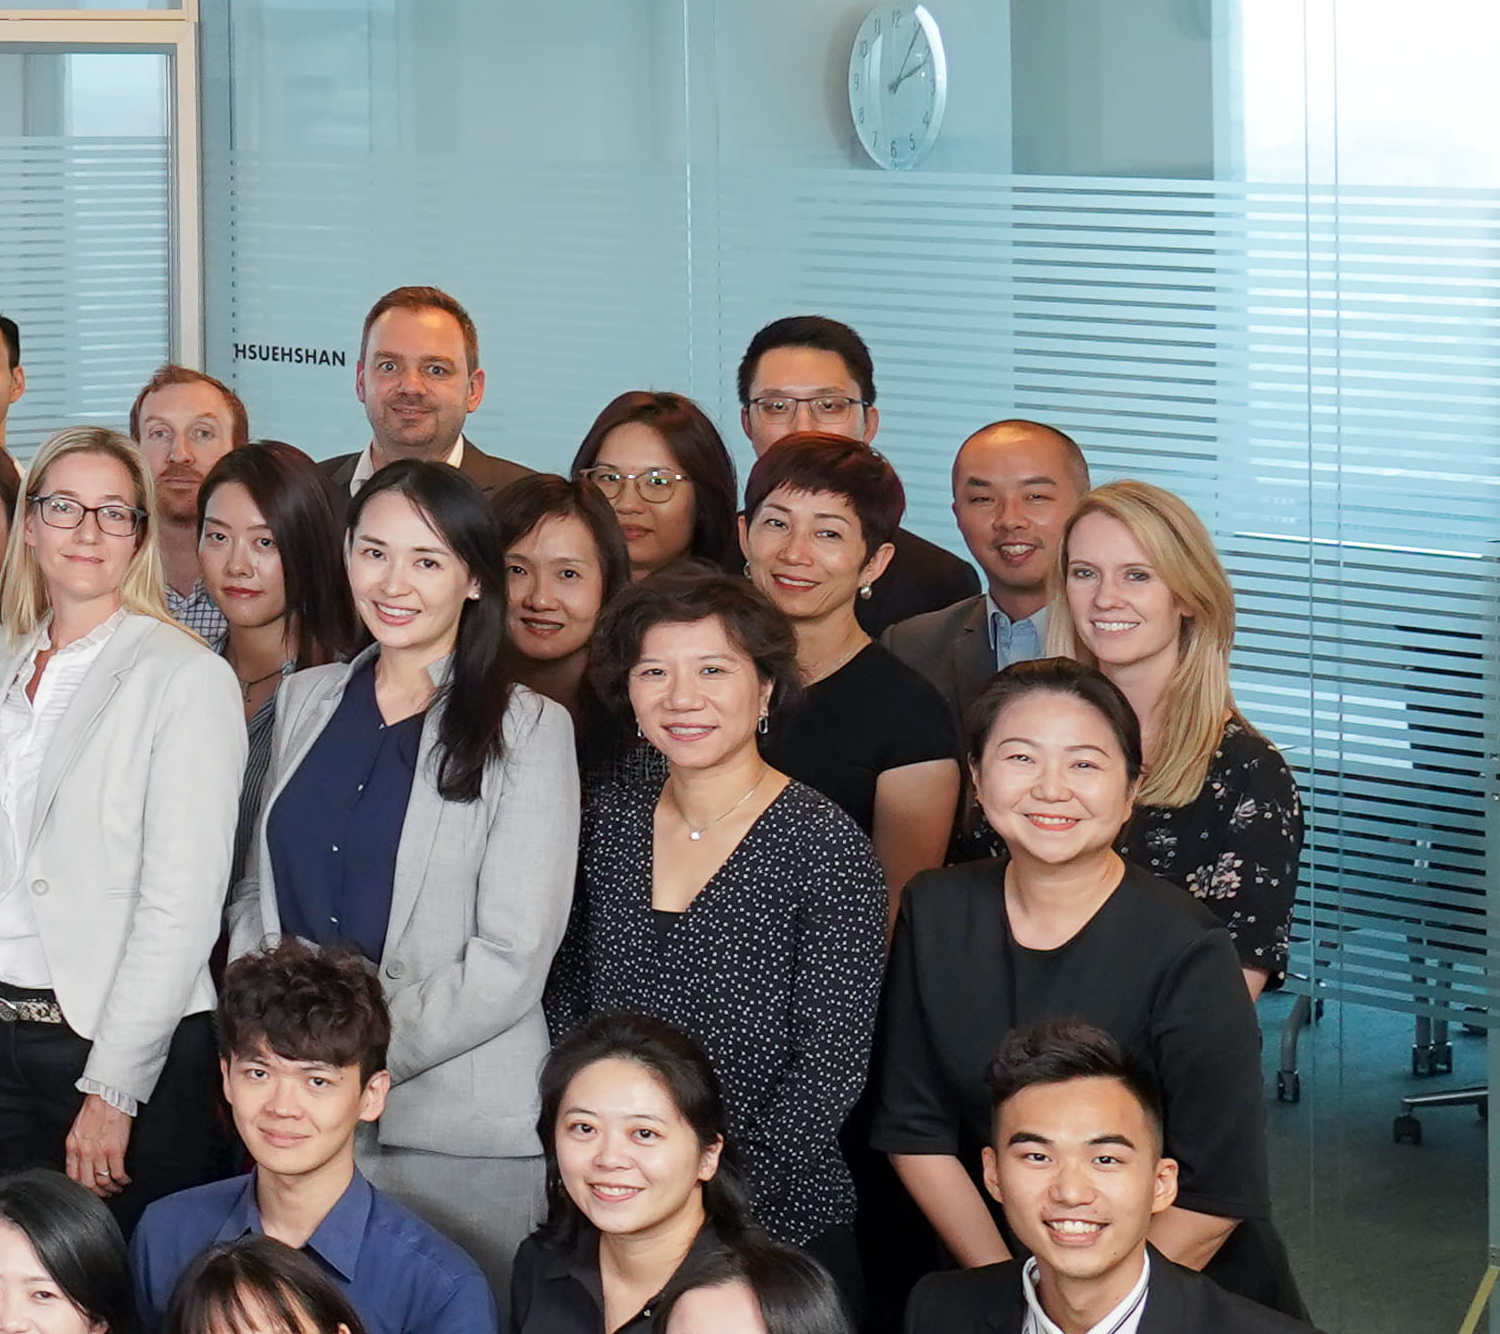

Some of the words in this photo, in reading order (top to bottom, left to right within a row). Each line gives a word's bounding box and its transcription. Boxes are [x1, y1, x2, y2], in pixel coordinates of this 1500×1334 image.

[891, 10, 901, 28] 12
[853, 73, 859, 91] 9
[872, 130, 878, 148] 7
[909, 132, 916, 151] 5
[890, 139, 897, 158] 6
[234, 343, 346, 367] HSUEHSHAN
